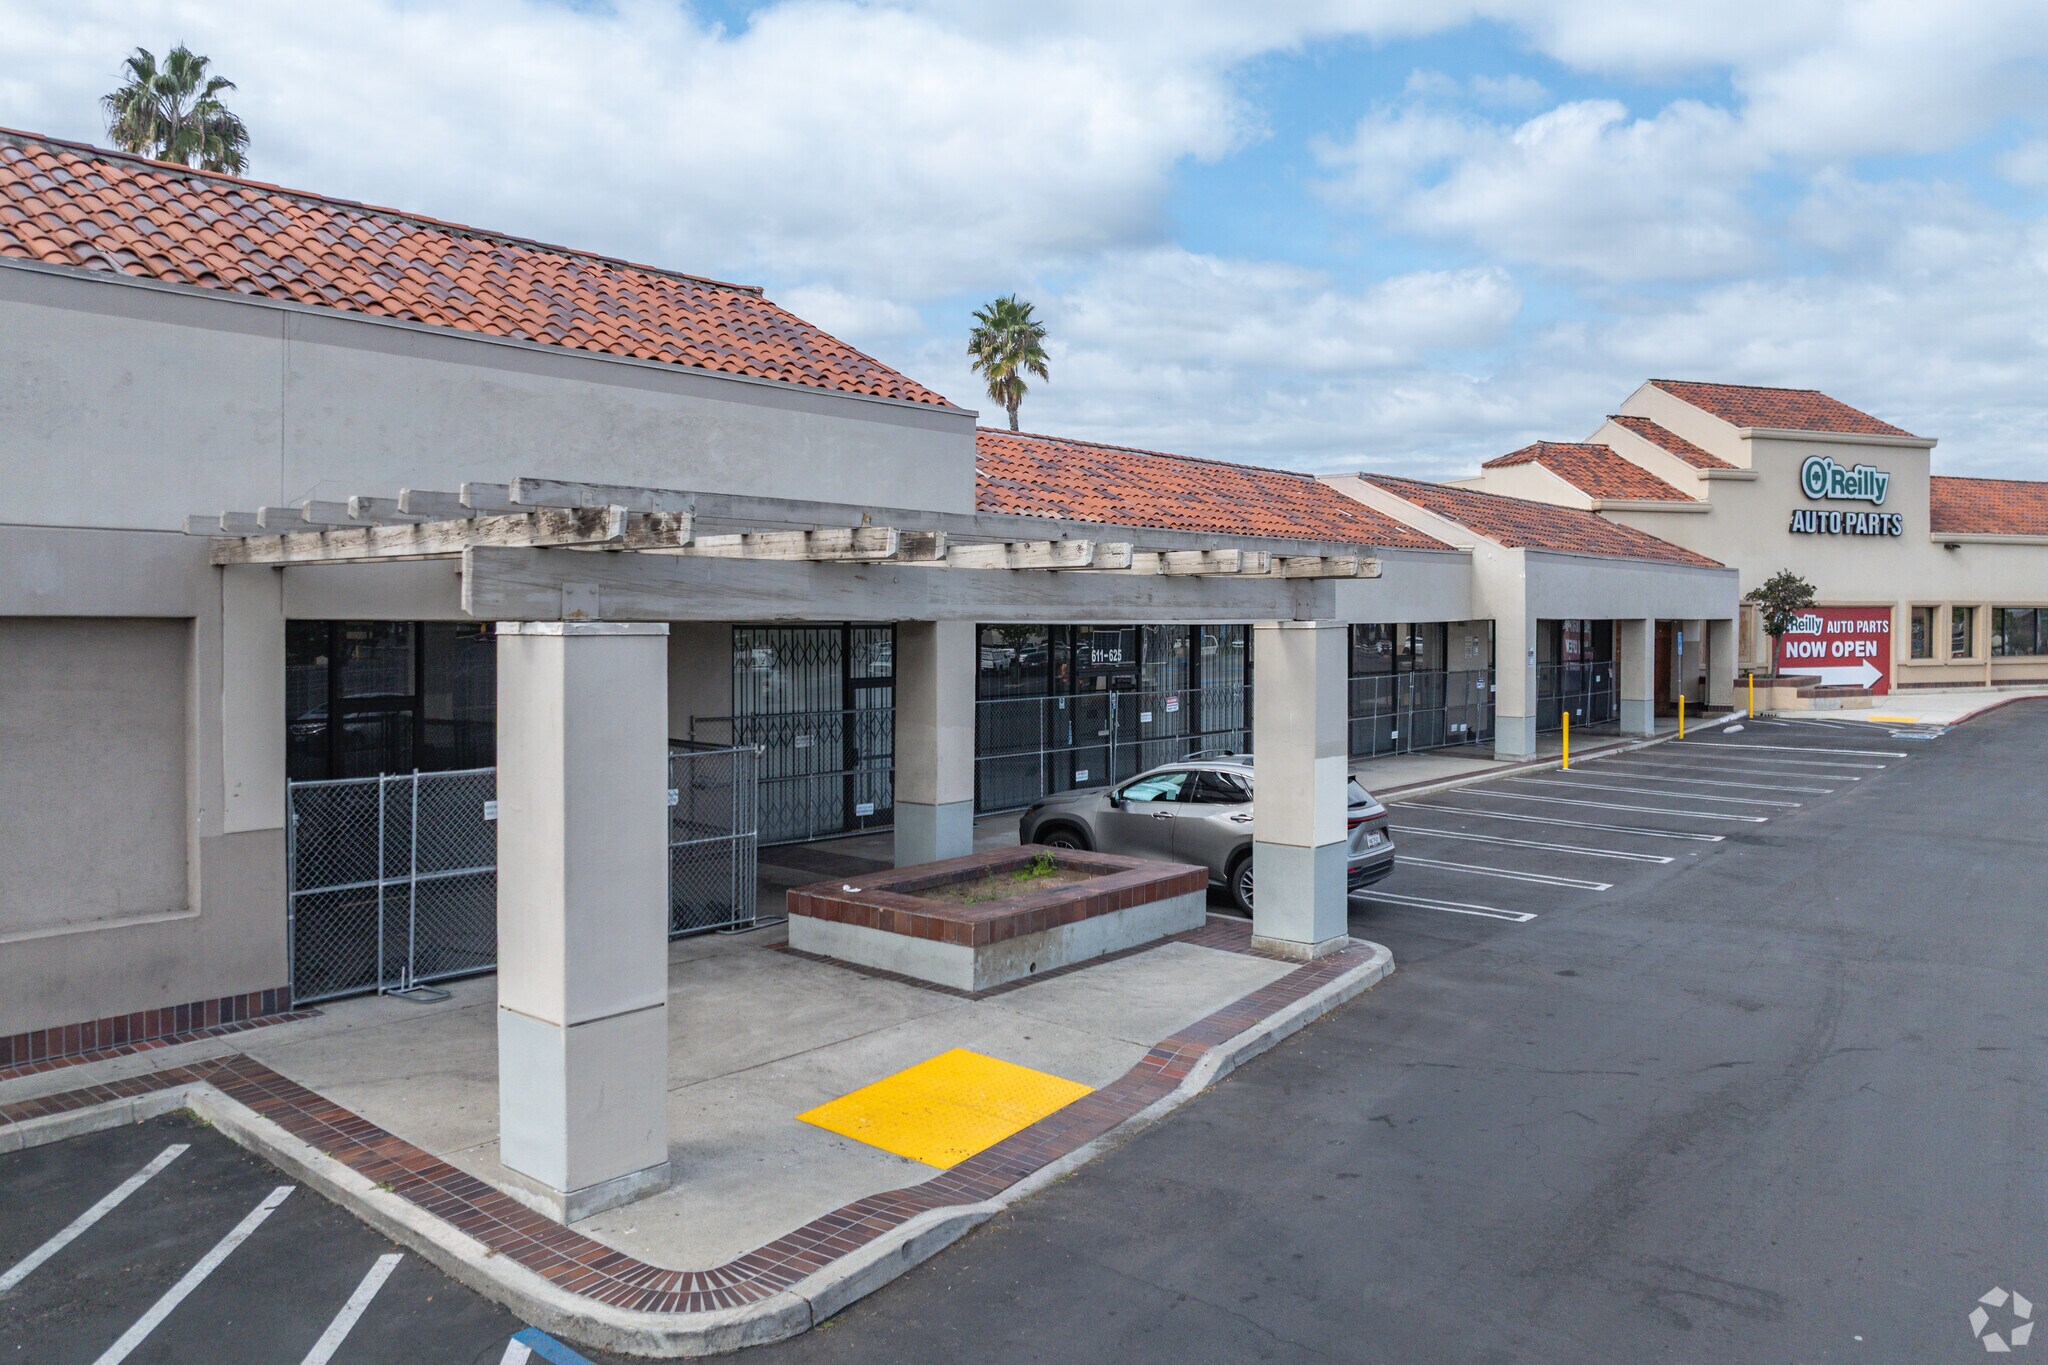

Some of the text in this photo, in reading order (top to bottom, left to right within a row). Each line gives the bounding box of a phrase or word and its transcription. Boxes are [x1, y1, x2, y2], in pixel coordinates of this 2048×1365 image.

[1804, 460, 1887, 501] O'Reilly
[1791, 510, 1902, 536] AUTO PARTS
[1827, 620, 1854, 634] AUTO
[1856, 620, 1889, 634] PARTS
[1091, 649, 1122, 662] 611-625
[1785, 640, 1878, 658] NOW OPEN
